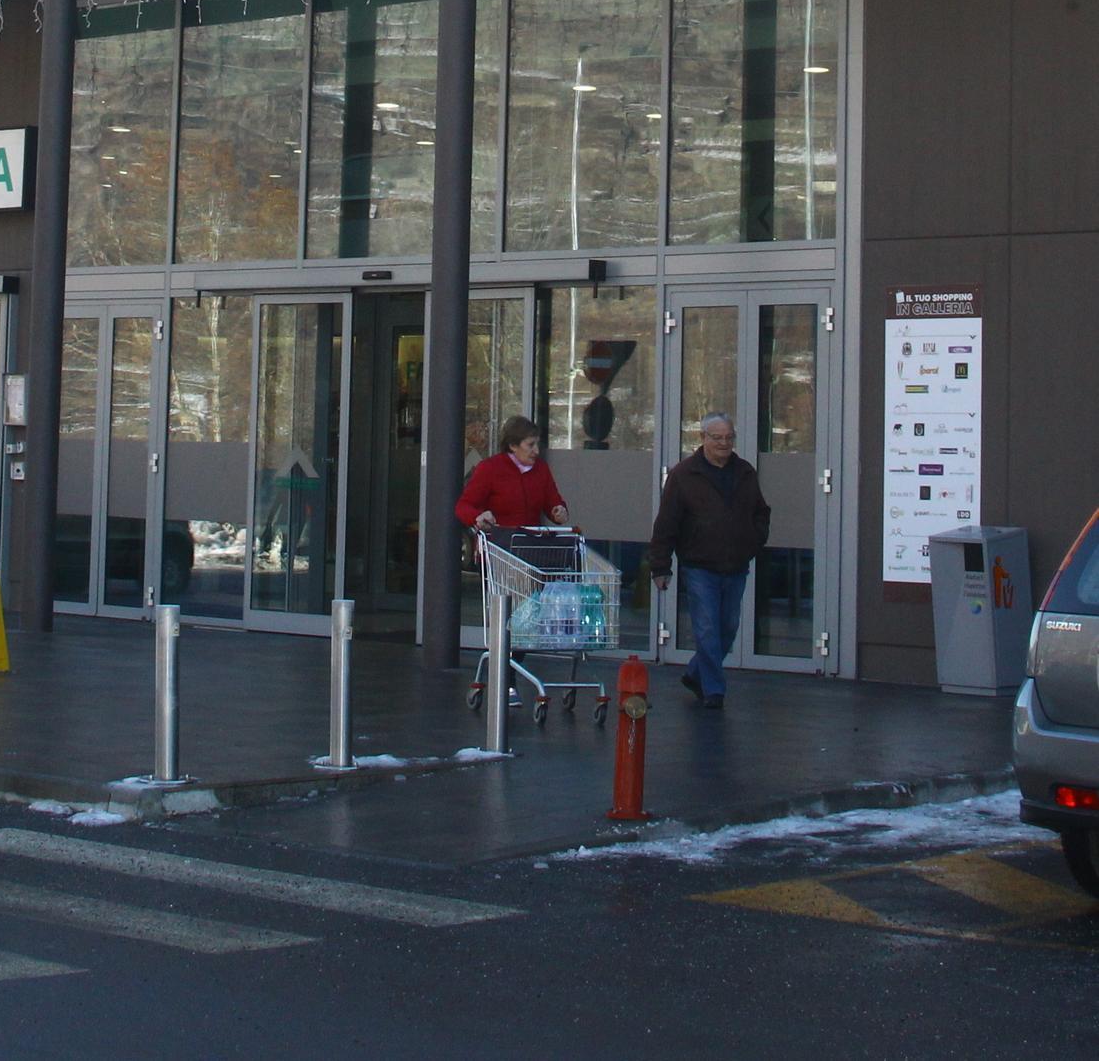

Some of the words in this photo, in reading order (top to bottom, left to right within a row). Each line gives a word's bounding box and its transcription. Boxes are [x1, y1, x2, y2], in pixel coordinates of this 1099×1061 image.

[914, 294, 930, 302] TUO
[932, 293, 973, 301] SHOPPING
[896, 303, 909, 315] IN
[912, 302, 974, 315] GALLERIA
[1046, 621, 1082, 631] SUZUKI
